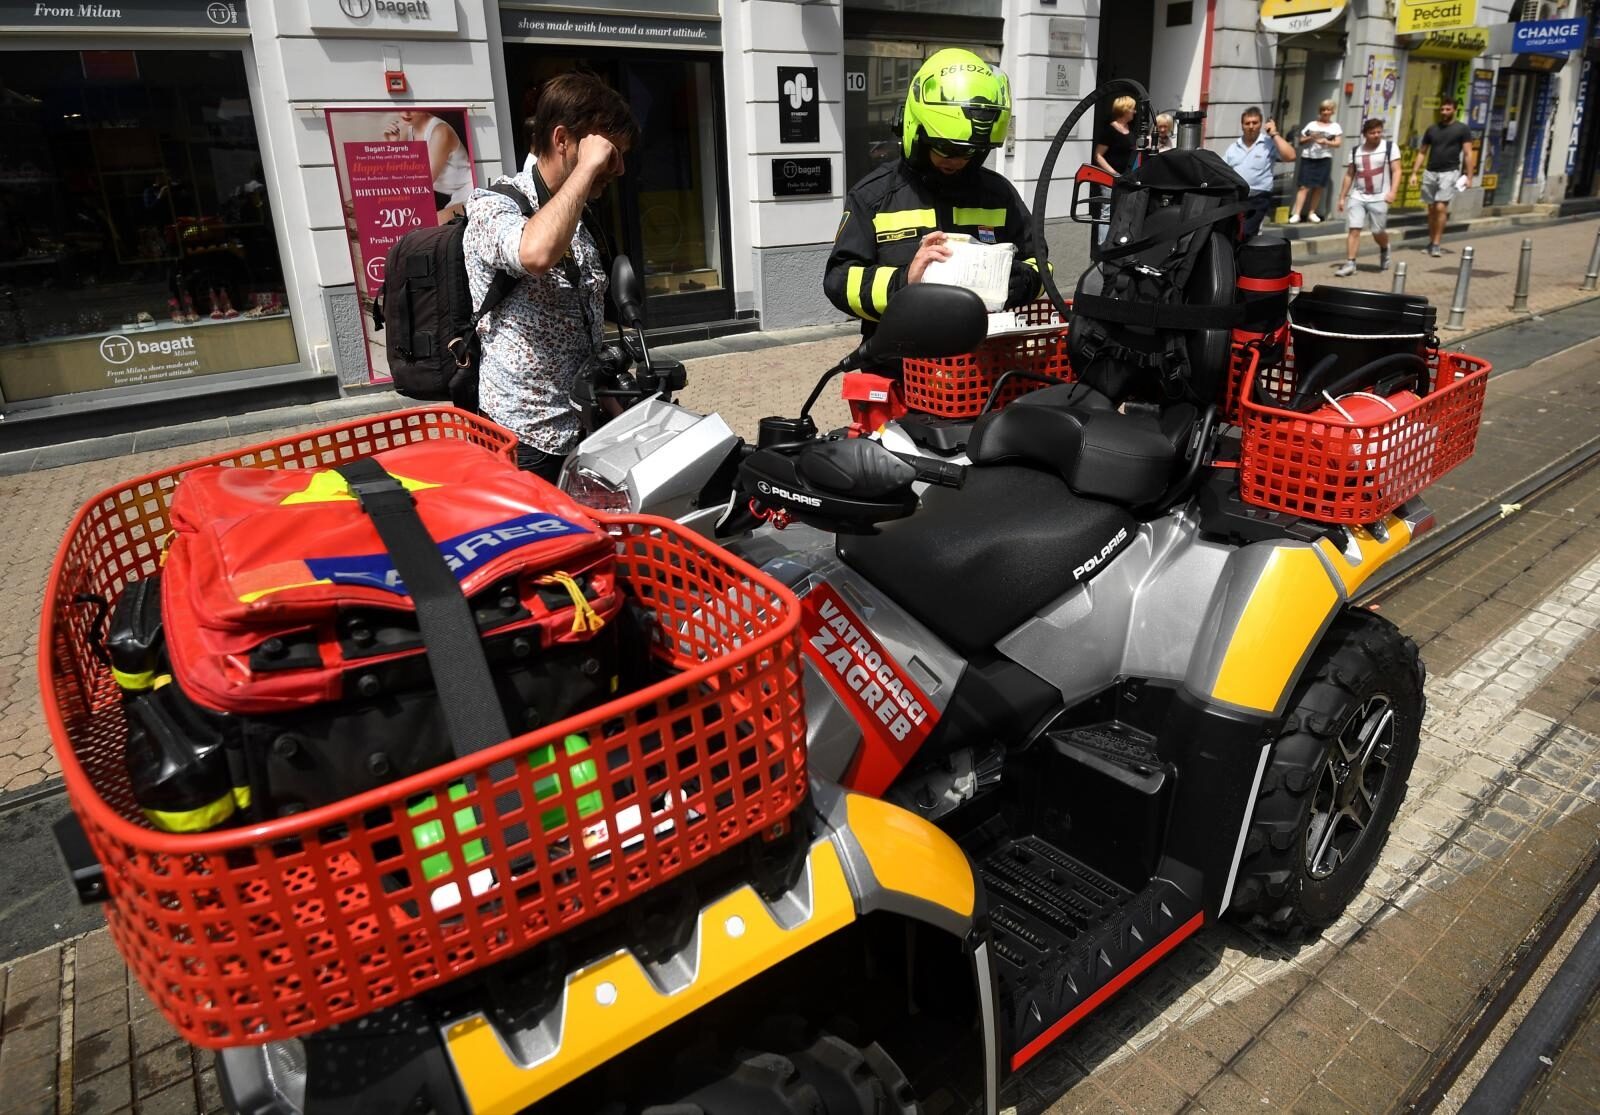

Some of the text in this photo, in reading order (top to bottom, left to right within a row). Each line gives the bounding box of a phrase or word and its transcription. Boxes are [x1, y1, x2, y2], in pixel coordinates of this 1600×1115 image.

[34, 3, 122, 18] From Milan
[1413, 4, 1462, 21] Pečati
[518, 18, 545, 30] shoes
[546, 21, 573, 32] made
[574, 22, 596, 33] with
[598, 22, 617, 34] love
[618, 25, 636, 35] and
[645, 27, 671, 37] smart
[672, 28, 708, 39] attitude.
[1288, 15, 1312, 29] style
[1517, 24, 1579, 39] CHANGE
[848, 74, 864, 89] 10
[364, 145, 409, 153] Bagatt Zagreb
[355, 186, 431, 197] BIRTHDAY WEEK
[374, 207, 422, 228] -20%
[370, 235, 394, 244] Praška
[136, 335, 195, 354] bagatt
[772, 486, 822, 507] POLARIS
[1072, 527, 1127, 580] POLARIS
[819, 598, 928, 727] VATROGASCI
[809, 626, 912, 742] ZAGREB
